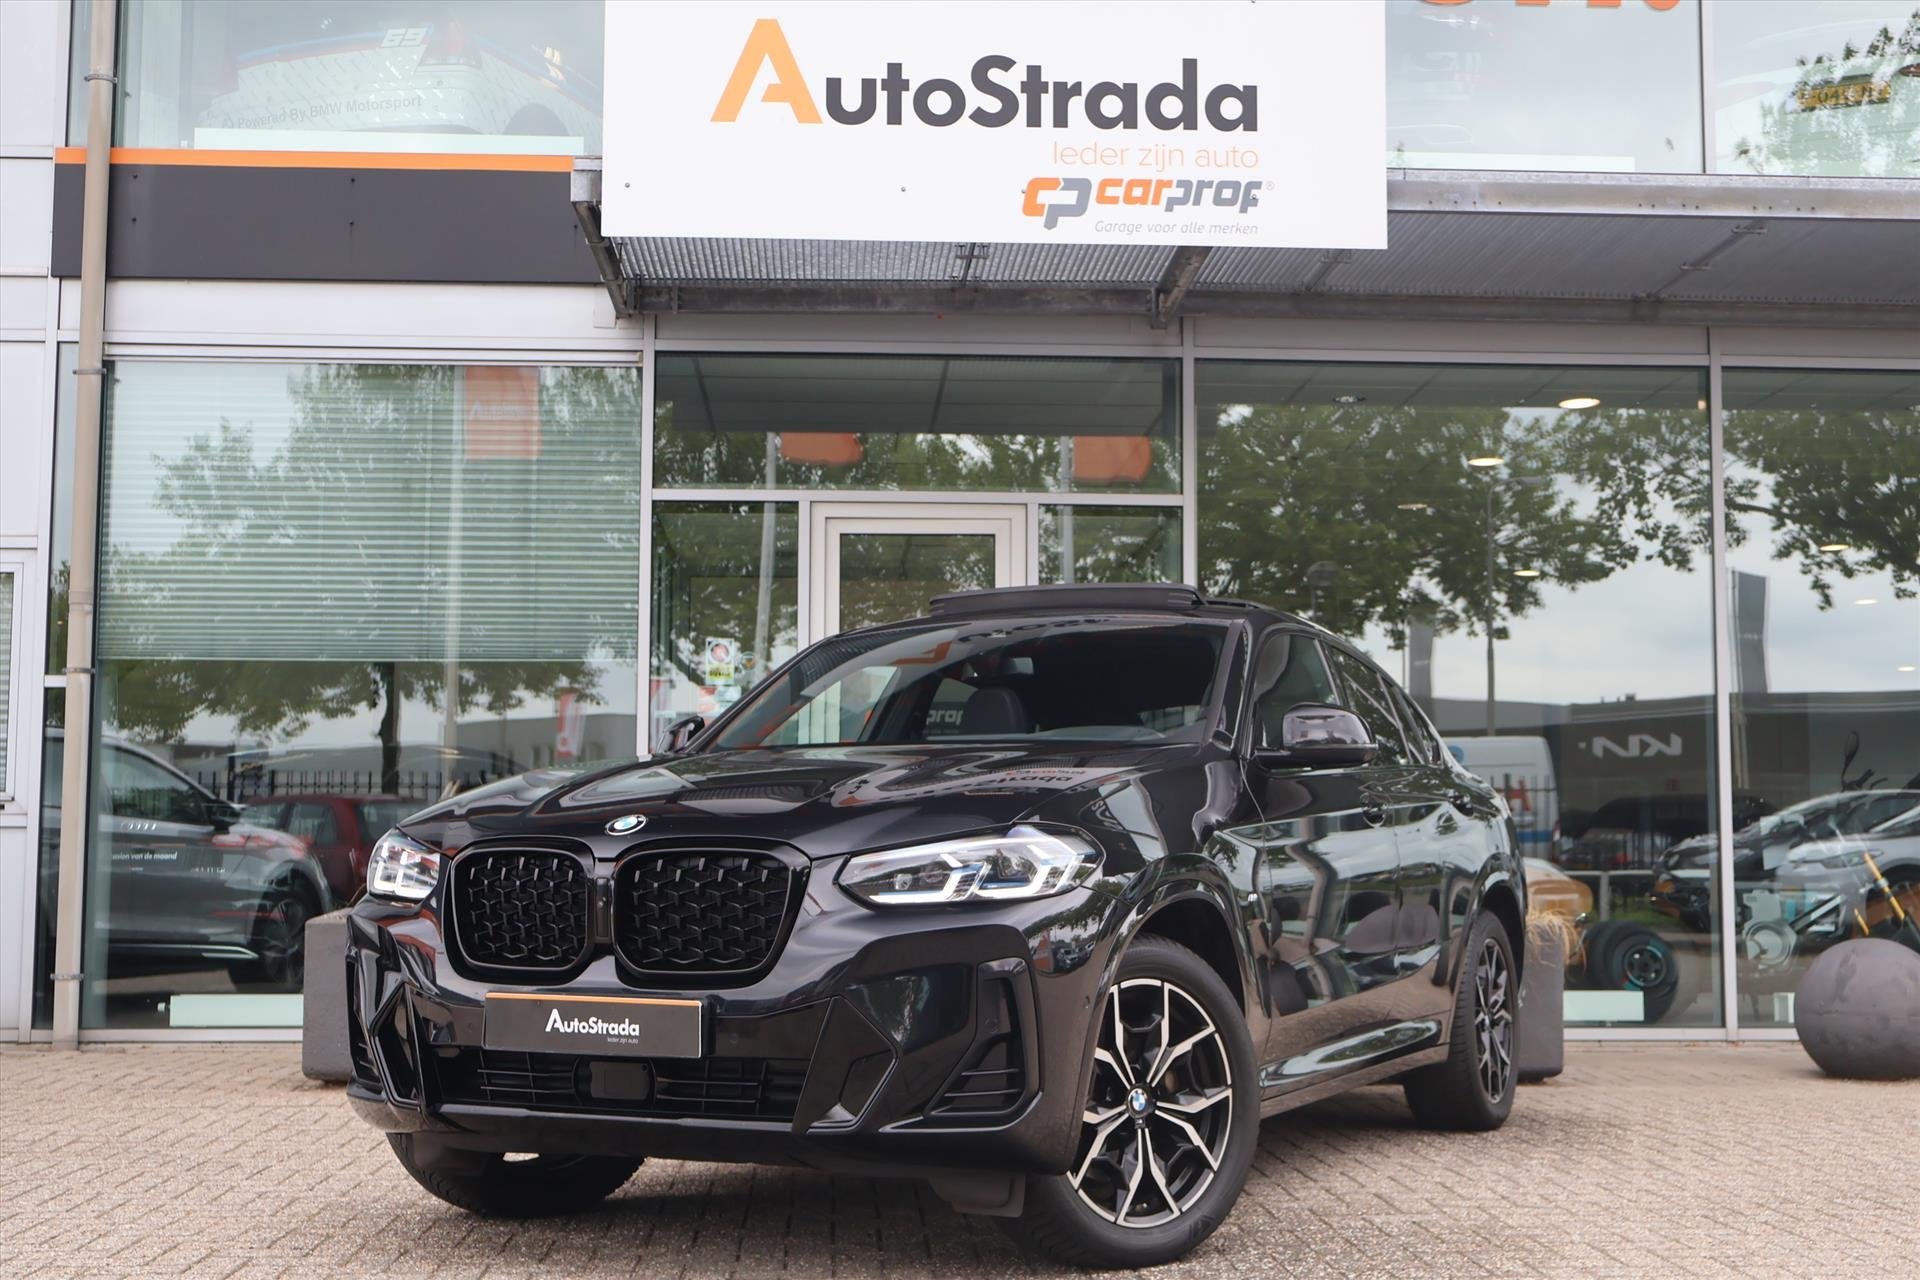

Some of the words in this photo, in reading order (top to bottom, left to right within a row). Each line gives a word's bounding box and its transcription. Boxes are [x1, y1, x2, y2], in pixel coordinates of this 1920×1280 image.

[710, 18, 1258, 132] AutoStrada
[290, 108, 307, 121] By
[310, 102, 342, 118] BMW
[346, 95, 423, 113] Motorsport
[1054, 141, 1129, 166] Ieder
[1138, 143, 1185, 173] zijn
[1195, 146, 1259, 169] auto
[1095, 220, 1143, 234] Garage
[1148, 223, 1176, 233] voor
[1180, 221, 1206, 234] alle
[1208, 222, 1259, 235] merken
[153, 851, 178, 860] maand
[545, 1008, 640, 1036] AutoStrada
